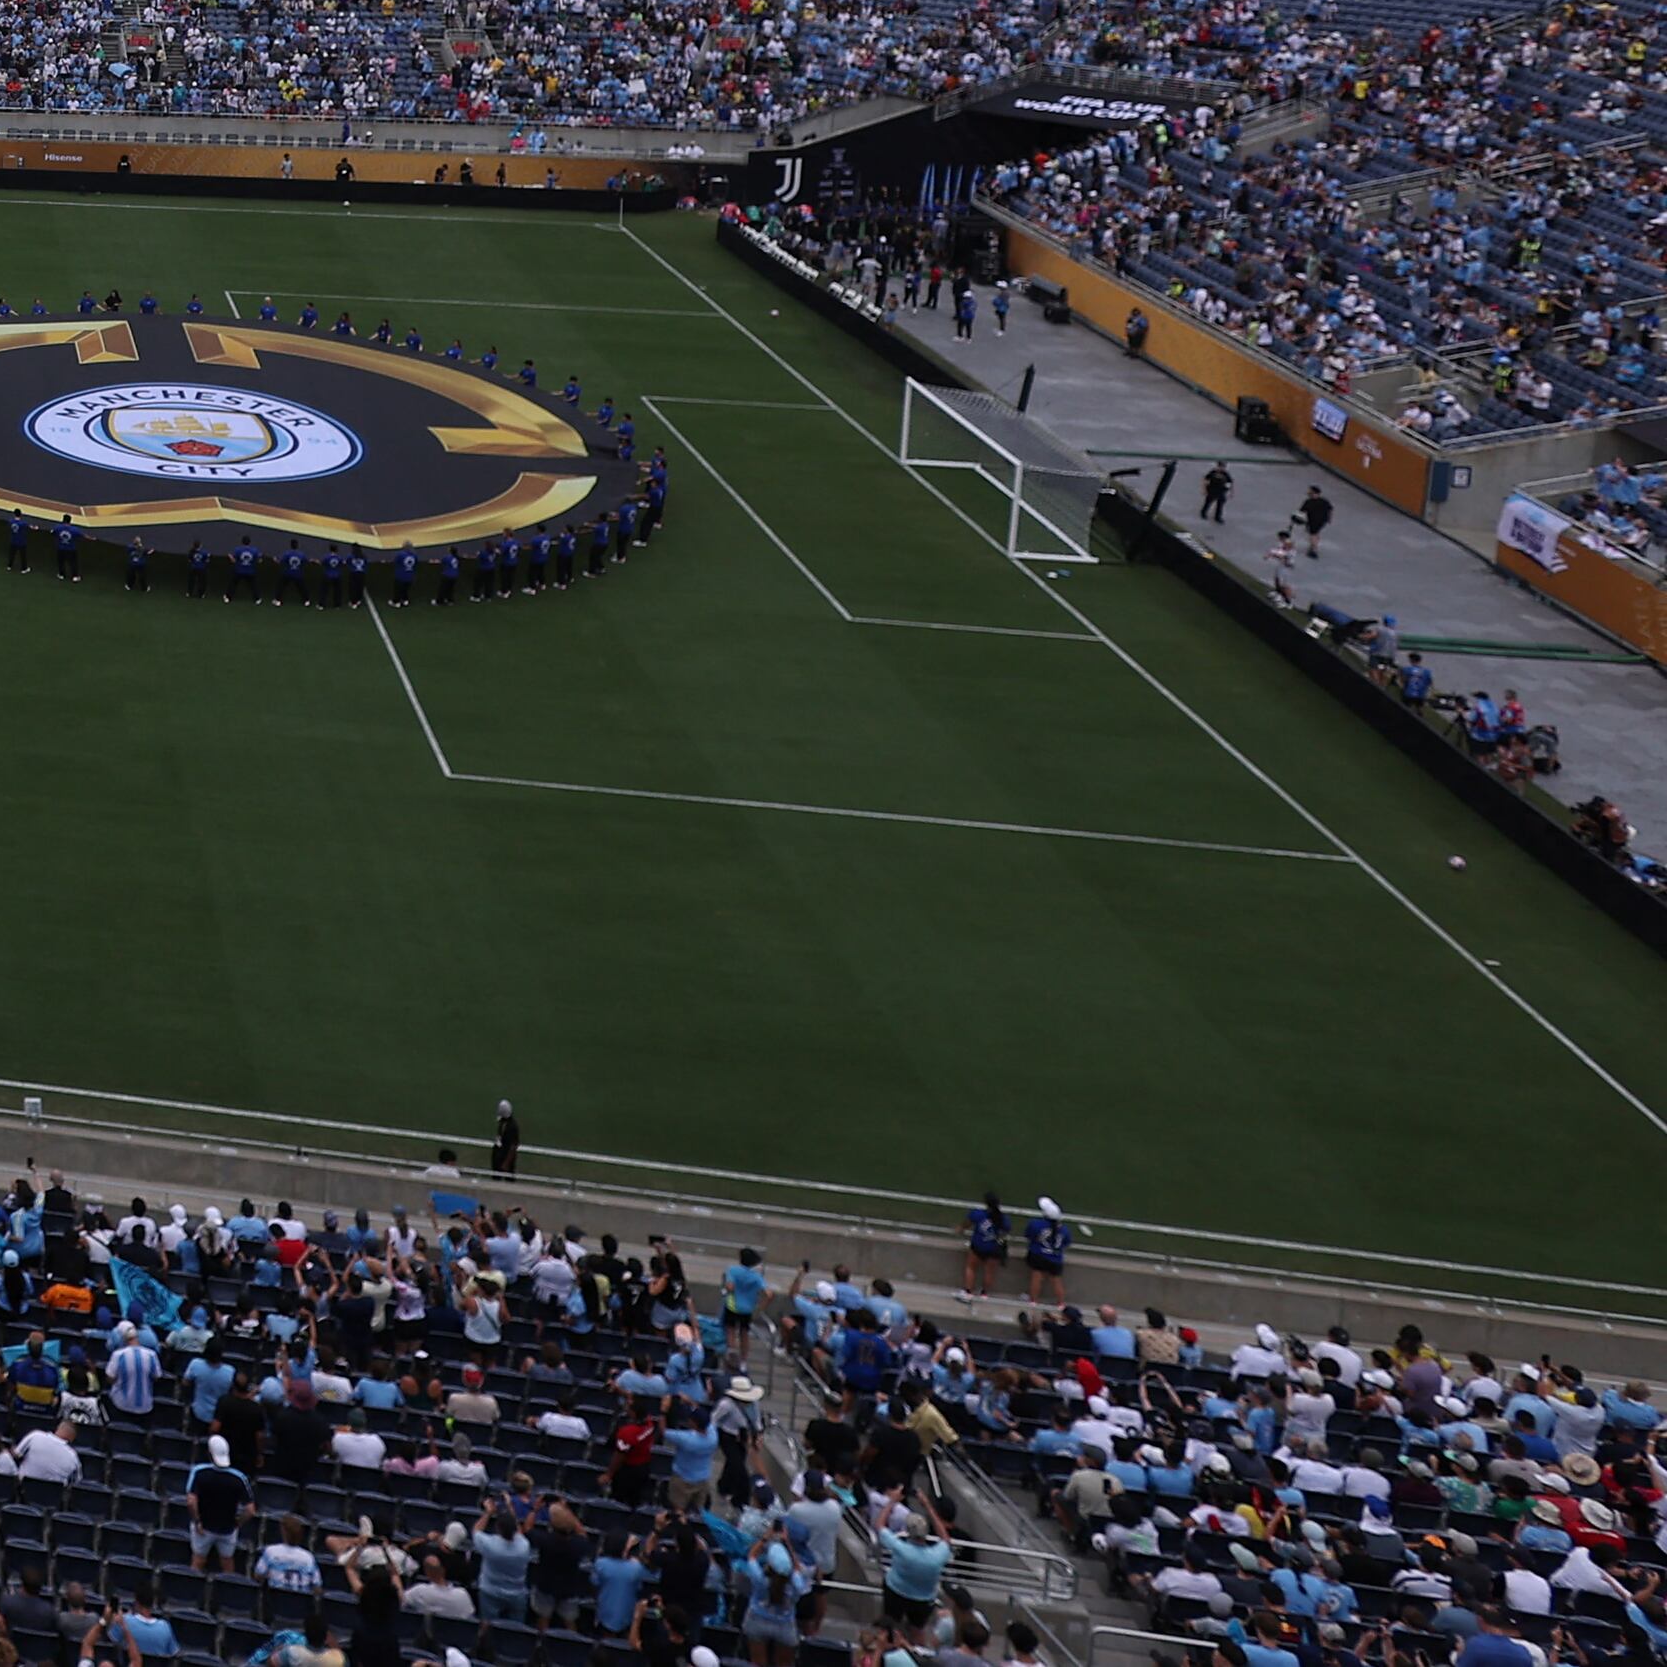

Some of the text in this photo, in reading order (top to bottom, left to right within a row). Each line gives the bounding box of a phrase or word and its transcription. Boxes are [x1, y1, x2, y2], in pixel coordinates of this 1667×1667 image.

[1059, 95, 1104, 108] FIFA
[1015, 99, 1092, 117] WORLD
[1092, 105, 1135, 121] CUP
[44, 153, 83, 162] Hisense
[55, 390, 316, 429] MANCHESTER
[156, 463, 254, 477] CITY
